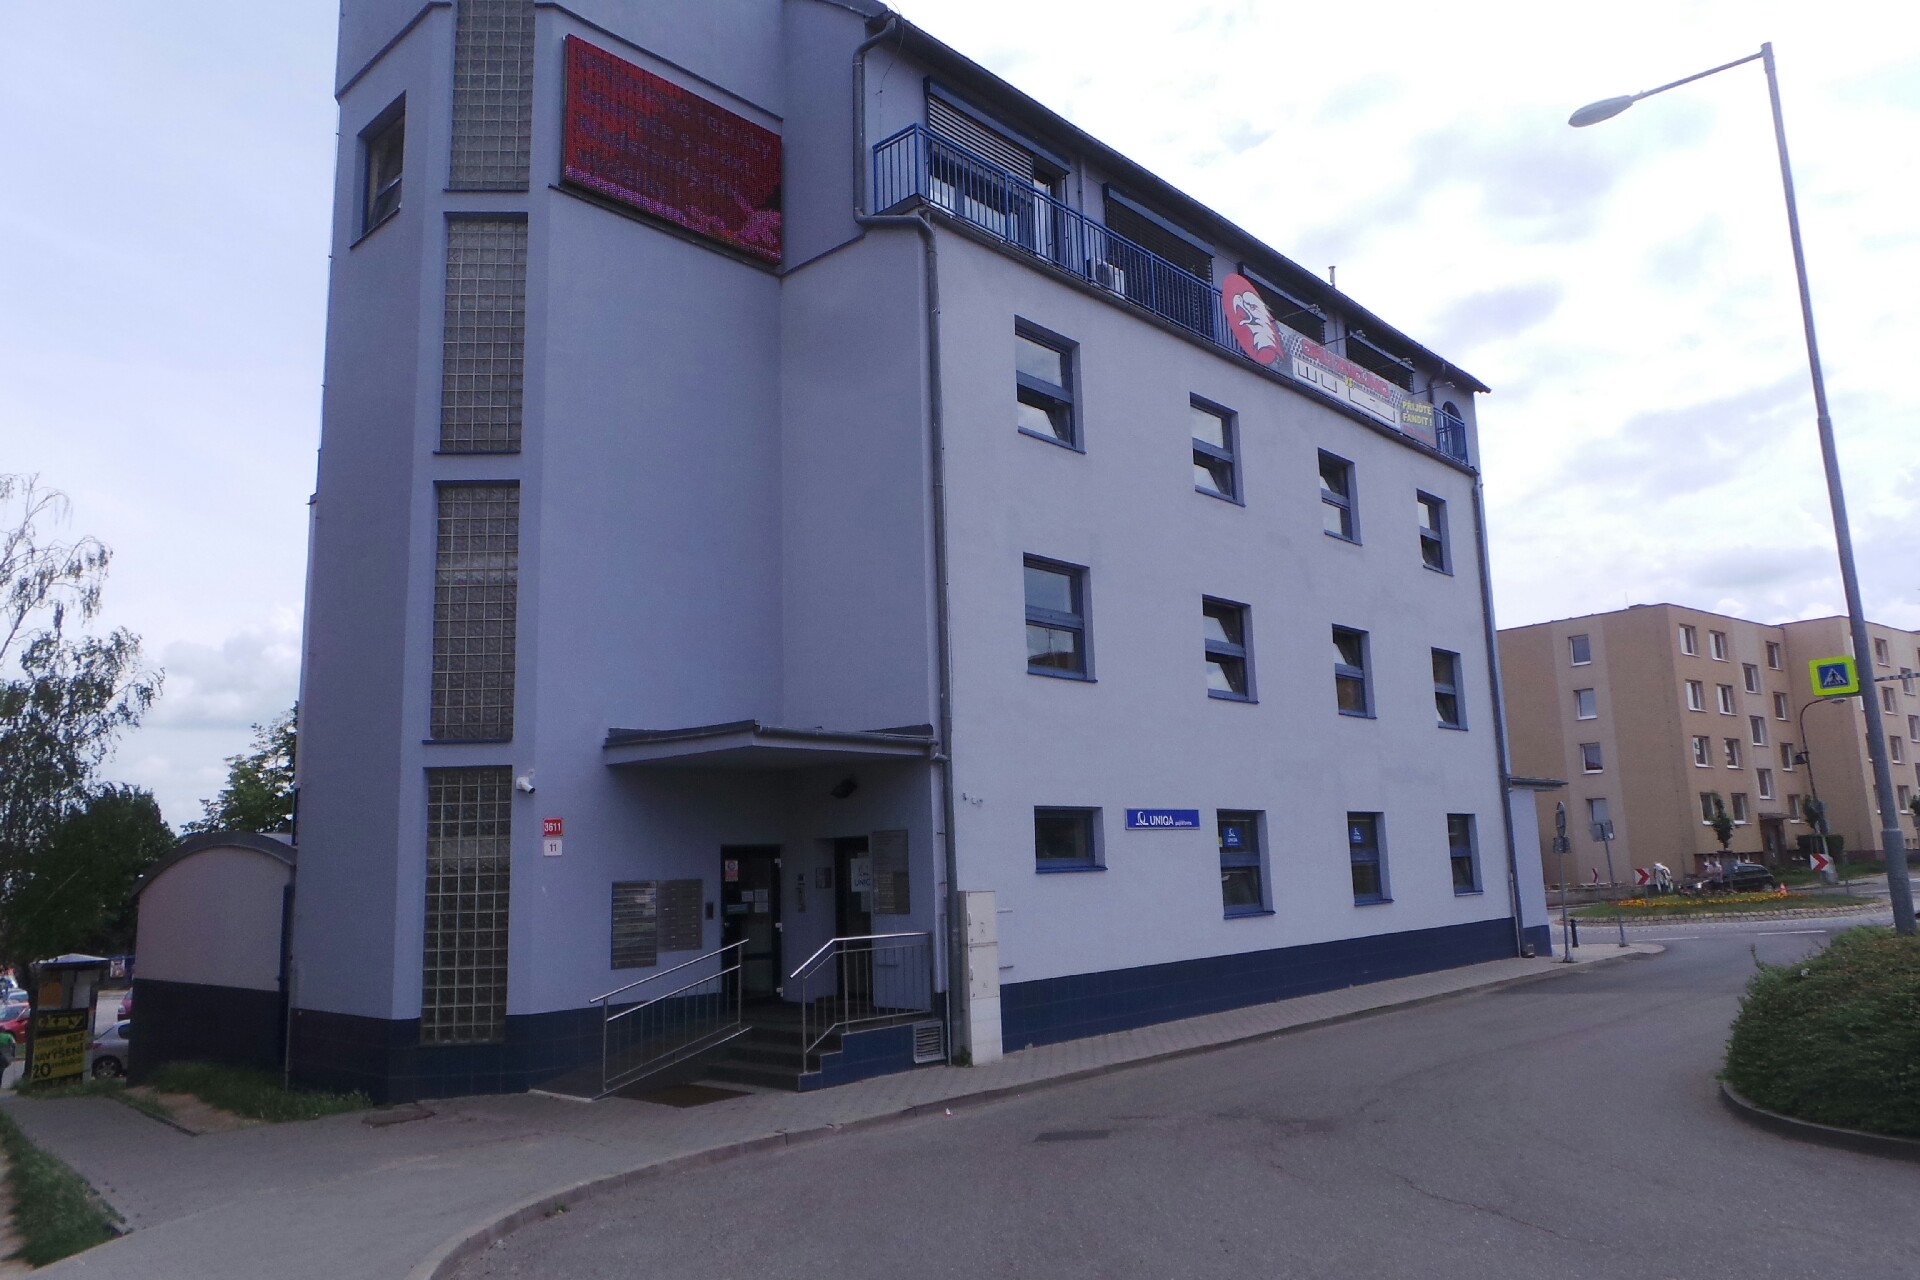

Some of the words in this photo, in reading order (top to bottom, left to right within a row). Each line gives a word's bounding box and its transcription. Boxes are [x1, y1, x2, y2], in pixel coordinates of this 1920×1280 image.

[1149, 815, 1174, 826] UNIQA
[544, 822, 561, 832] 3611
[549, 843, 557, 852] 11
[33, 1063, 51, 1079] 20
